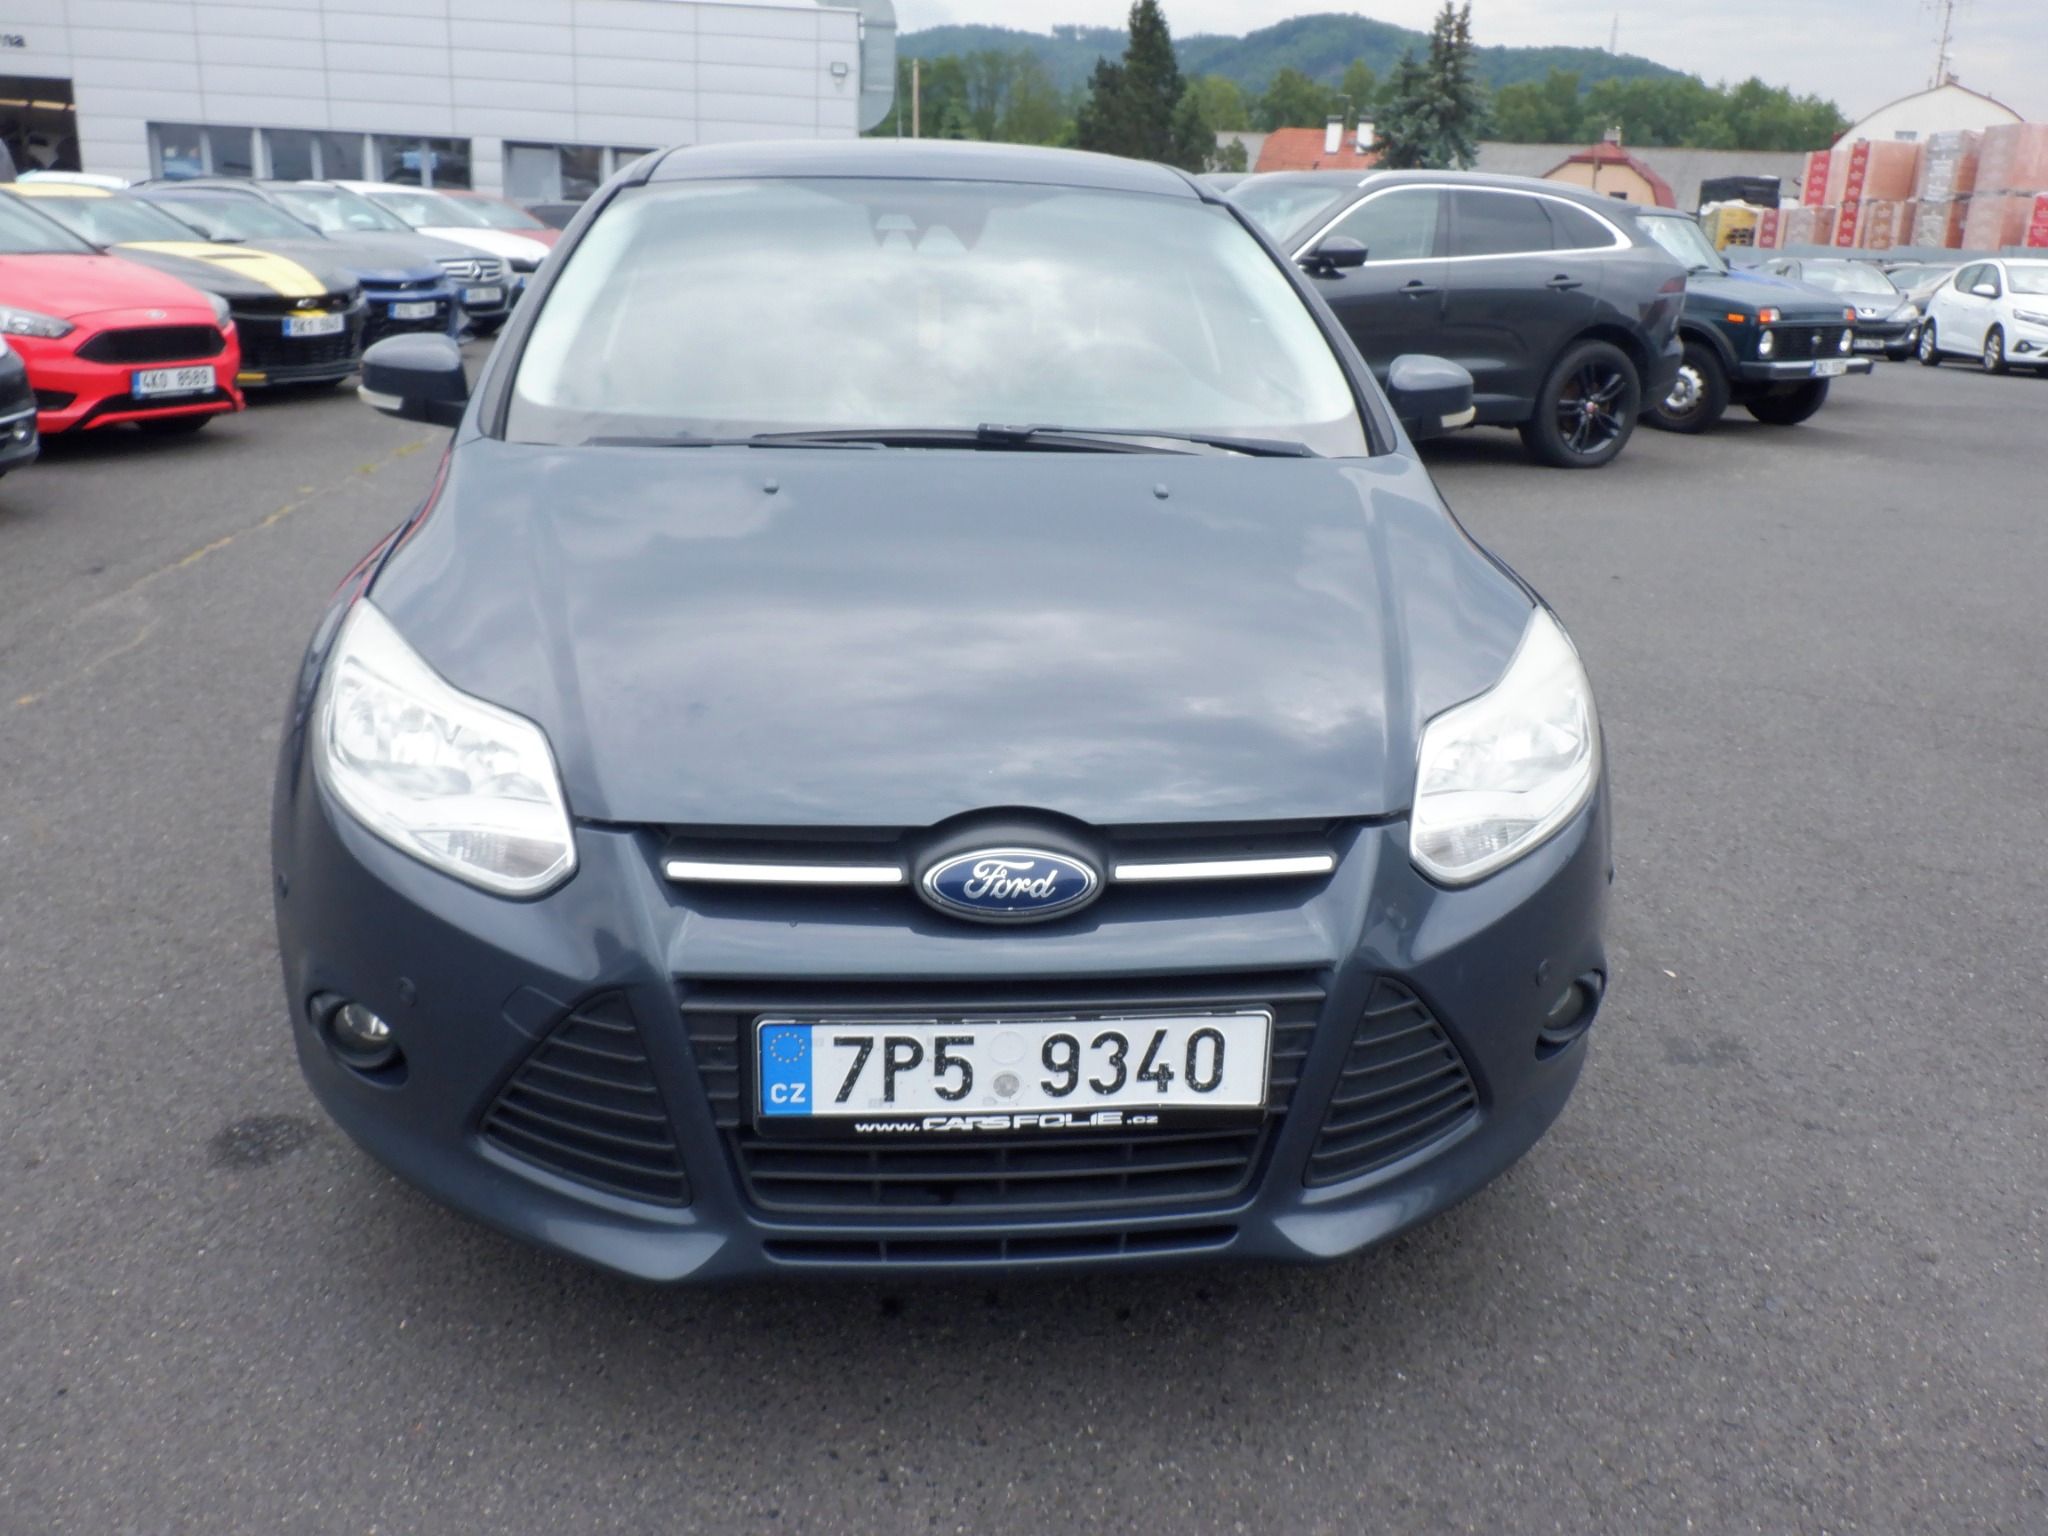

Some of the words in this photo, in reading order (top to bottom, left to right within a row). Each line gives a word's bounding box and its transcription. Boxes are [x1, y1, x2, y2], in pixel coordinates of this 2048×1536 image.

[963, 859, 1058, 899] Ford
[833, 1036, 975, 1103] 7P5
[1041, 1027, 1225, 1097] 9340
[770, 1083, 806, 1104] CZ
